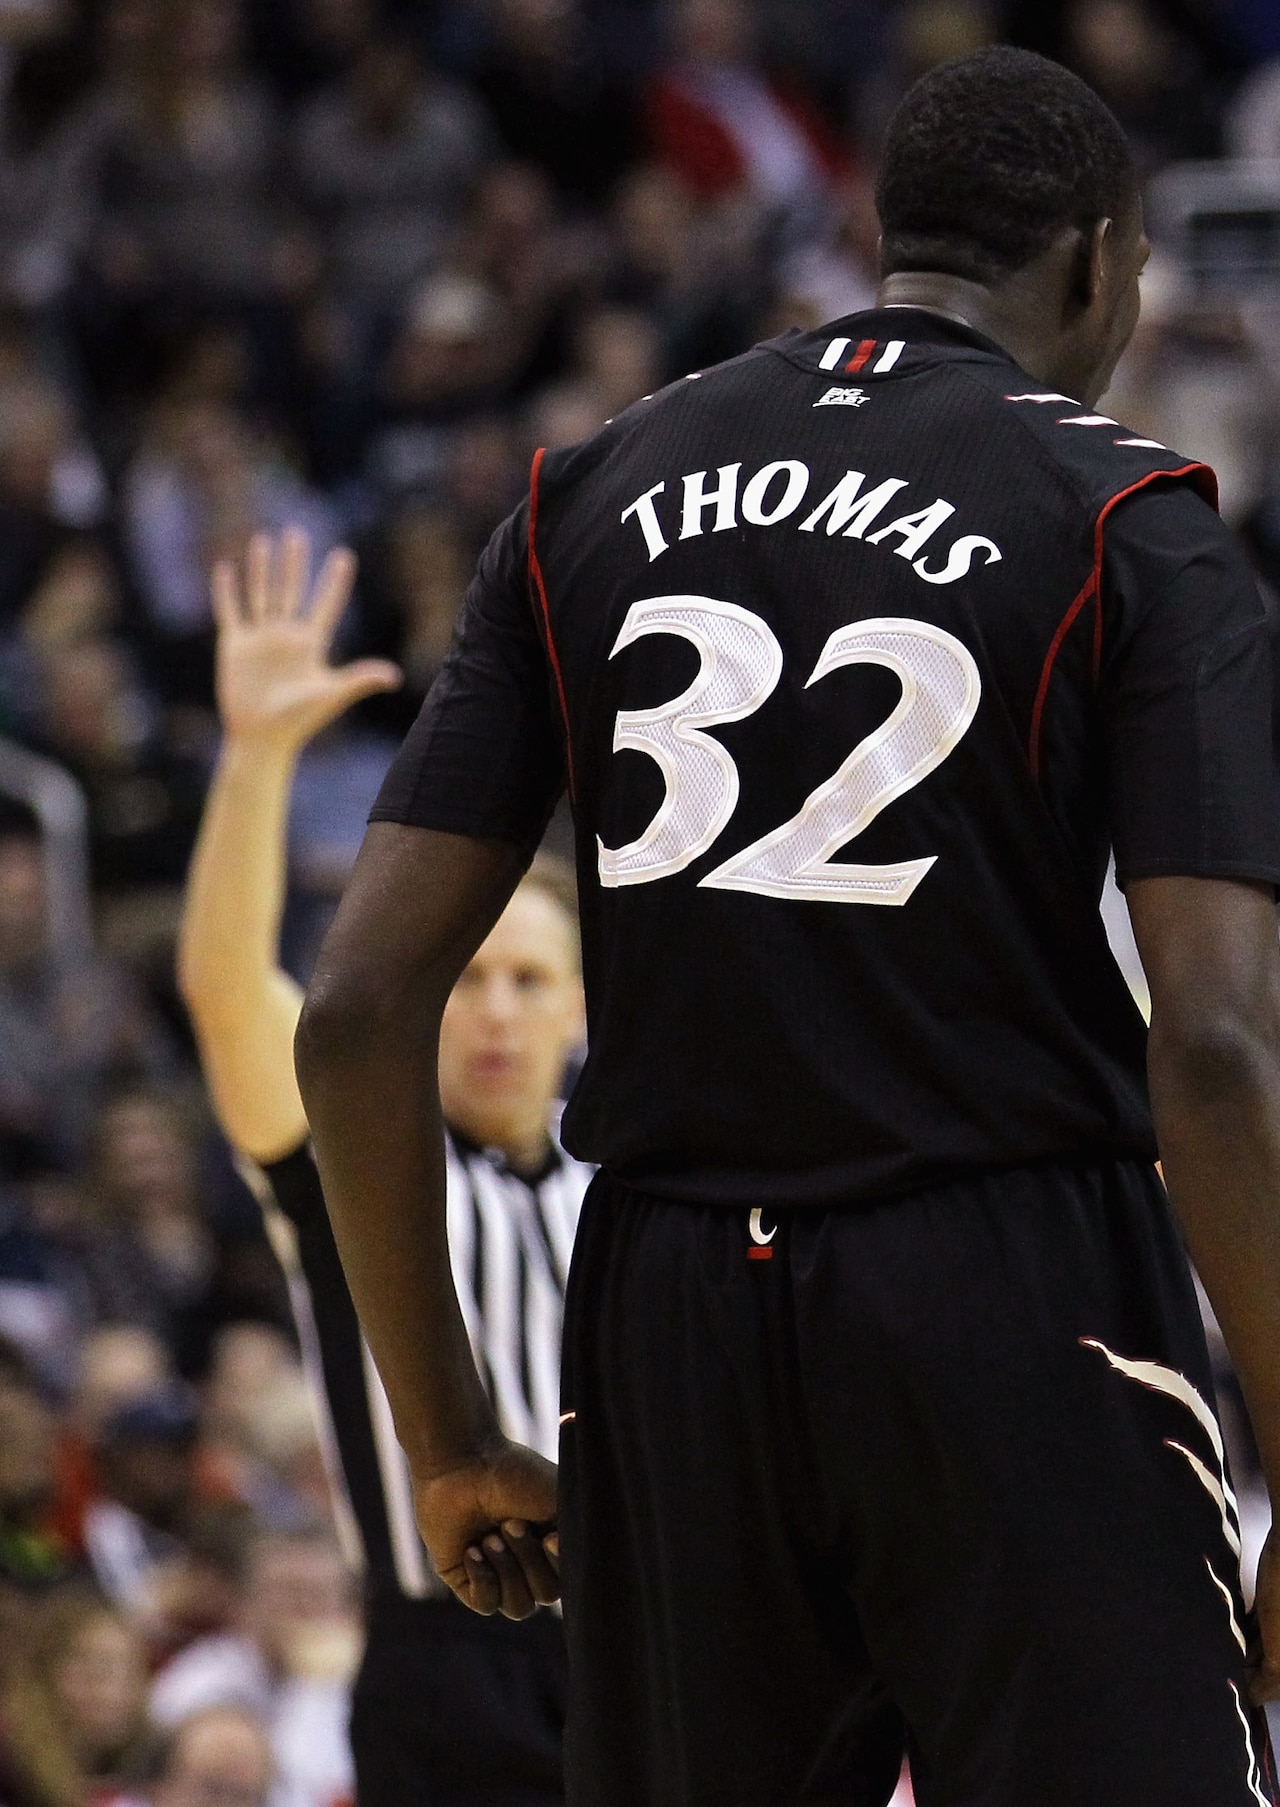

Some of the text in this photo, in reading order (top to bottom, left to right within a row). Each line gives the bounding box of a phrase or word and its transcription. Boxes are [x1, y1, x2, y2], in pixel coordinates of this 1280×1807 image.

[819, 395, 871, 404] EAST
[827, 387, 864, 396] BIG
[620, 459, 1002, 584] THOMAS
[596, 595, 982, 906] 32
